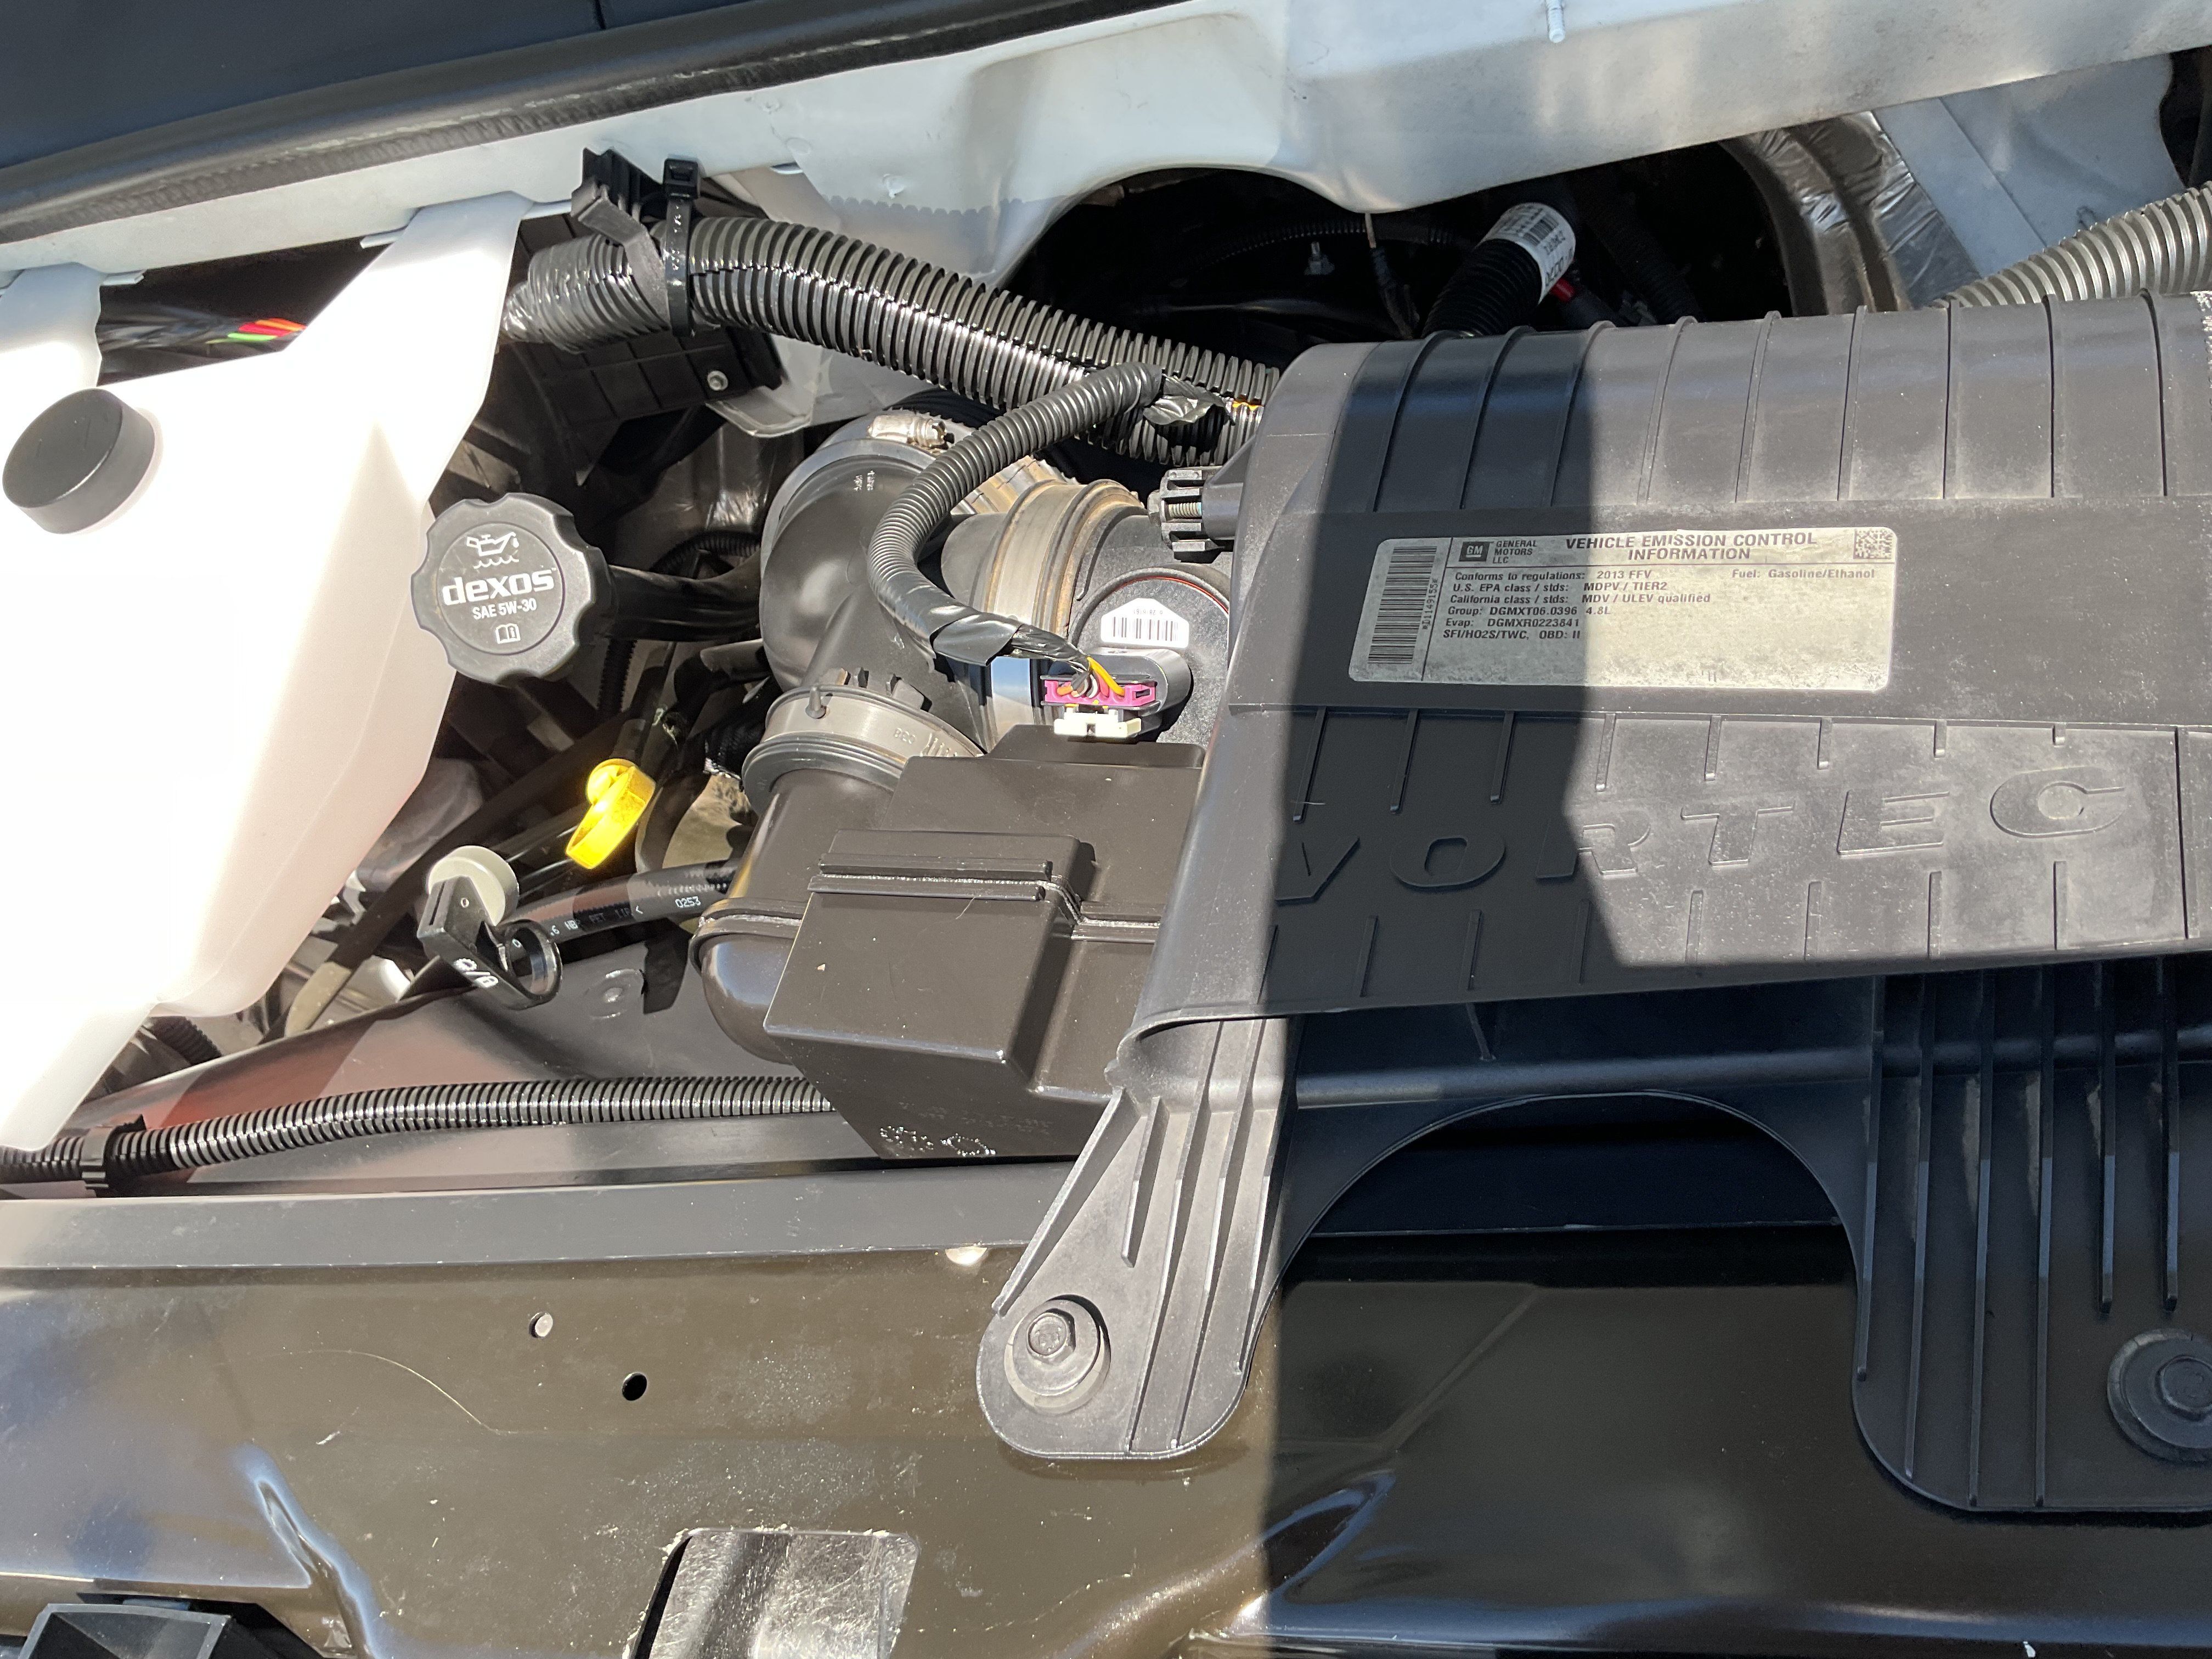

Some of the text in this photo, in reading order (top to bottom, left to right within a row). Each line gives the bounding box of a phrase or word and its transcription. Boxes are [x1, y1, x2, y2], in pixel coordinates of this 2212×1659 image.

[1566, 532, 1818, 549] VEHICLE EMISSION CONTROL
[1466, 545, 1483, 555] GM
[1628, 548, 1751, 561] INFORMATION
[1455, 572, 1503, 580] Conforms
[1521, 571, 1585, 582] regulations:
[1596, 570, 1625, 579] 2013
[1628, 569, 1652, 579] FFV
[1732, 568, 1875, 579] Fuel: Gasoline/Ethanol
[442, 569, 555, 606] dexos
[1453, 583, 1474, 592] U.S.
[1479, 583, 1500, 592] EPA
[1504, 583, 1531, 592] class
[1543, 583, 1568, 592] stds:
[1584, 582, 1619, 591] MDPV
[1631, 582, 1667, 591] TIER2
[1450, 594, 1500, 604] California
[1504, 595, 1531, 604] class
[1543, 594, 1568, 604] stds:
[1582, 594, 1610, 603] MDV
[1622, 594, 1655, 603] ULEV
[1658, 592, 1711, 605] qualified
[472, 597, 538, 620] SAE 5W-30
[1448, 606, 1611, 617] Group: DGMXT06.0396 4.8L
[1446, 618, 1579, 629] Evap: DGMXR0223841
[1539, 630, 1568, 640] OBD:
[1572, 630, 1581, 639] II
[1274, 765, 2126, 904] VORTEC
[675, 896, 702, 909] 0253
